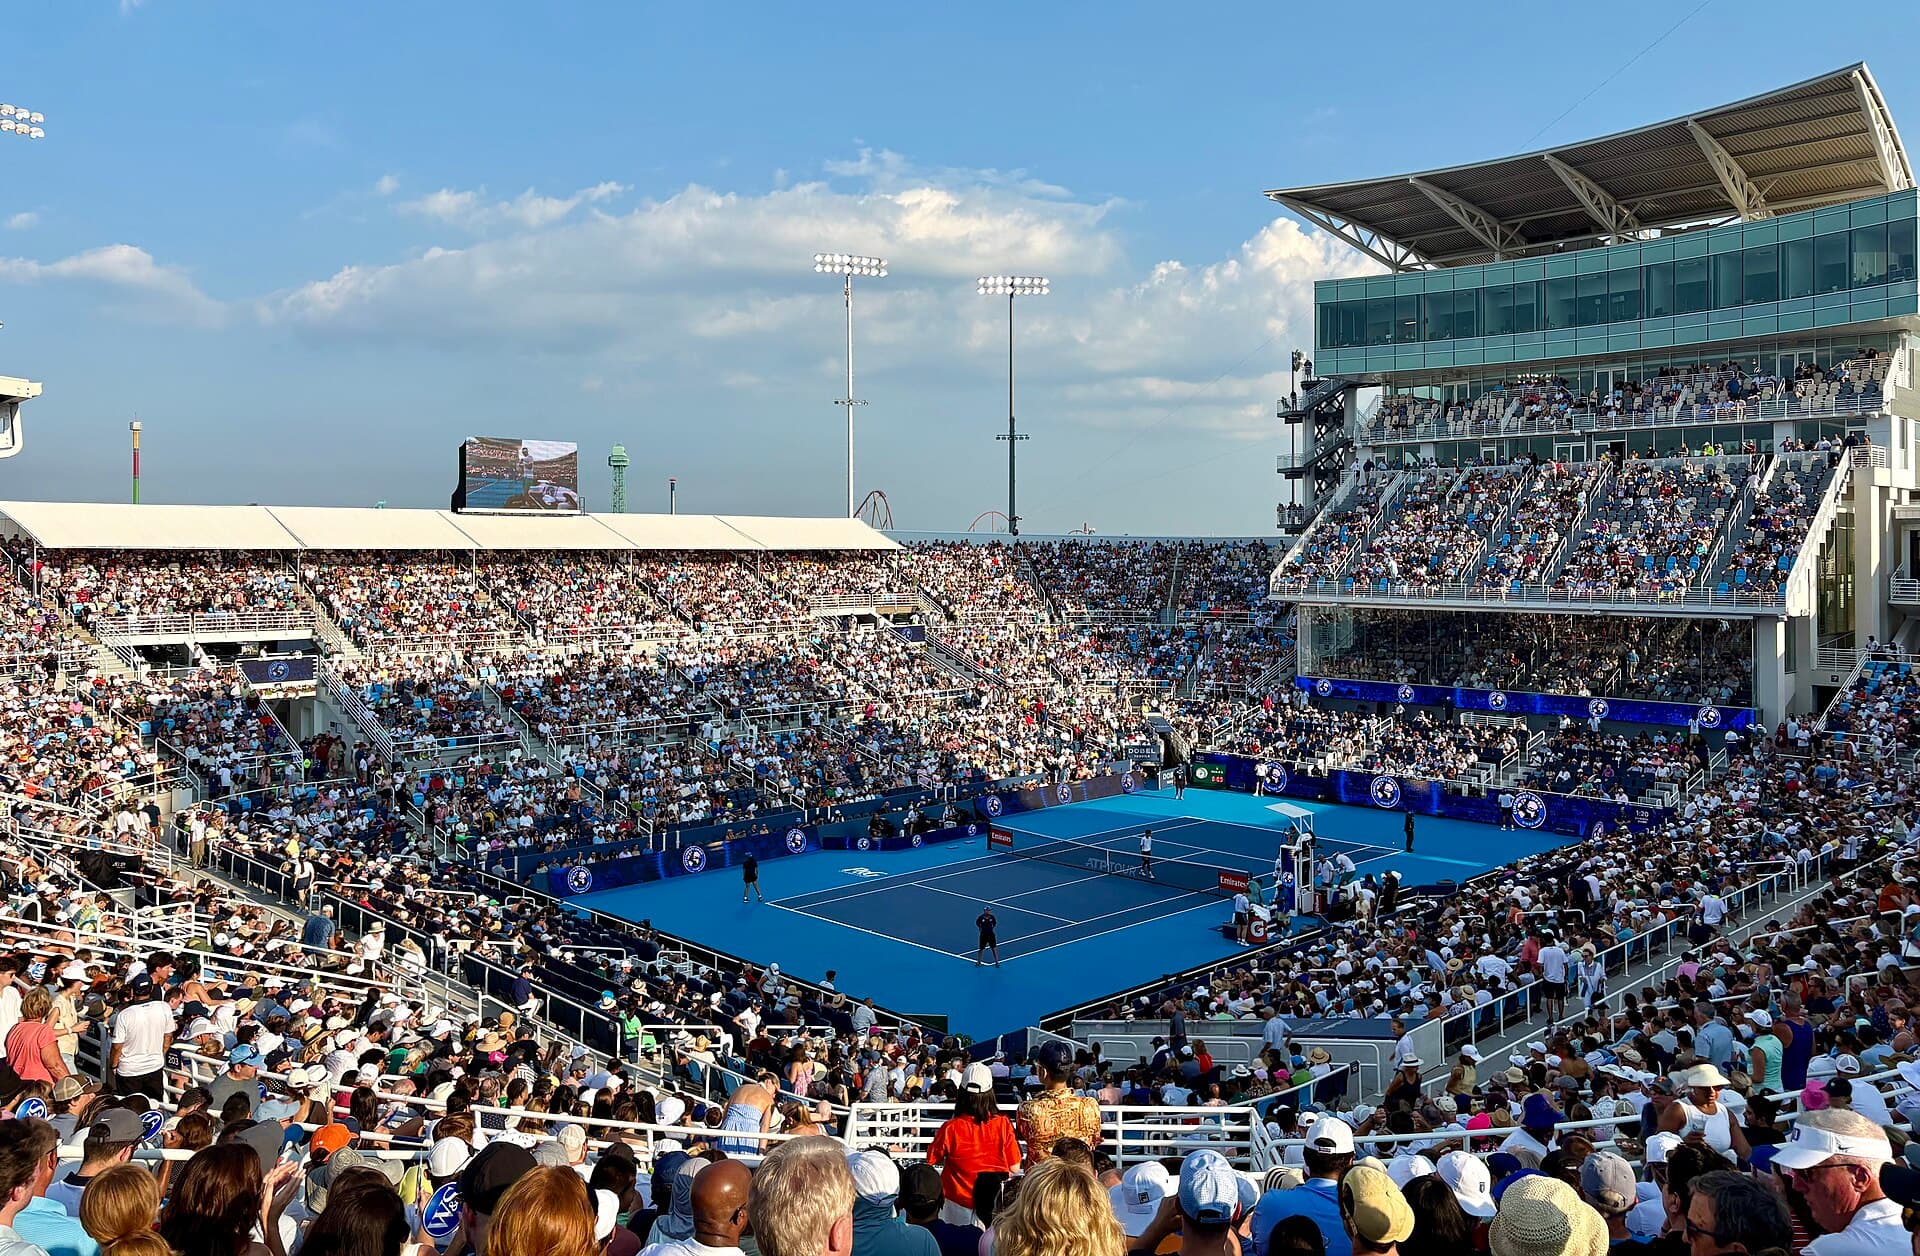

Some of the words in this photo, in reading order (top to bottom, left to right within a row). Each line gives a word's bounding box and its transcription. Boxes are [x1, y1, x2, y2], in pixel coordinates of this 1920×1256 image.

[991, 832, 1012, 842] Emirates
[1220, 876, 1249, 888] Emirates
[1250, 921, 1264, 937] G
[168, 1055, 178, 1066] 203
